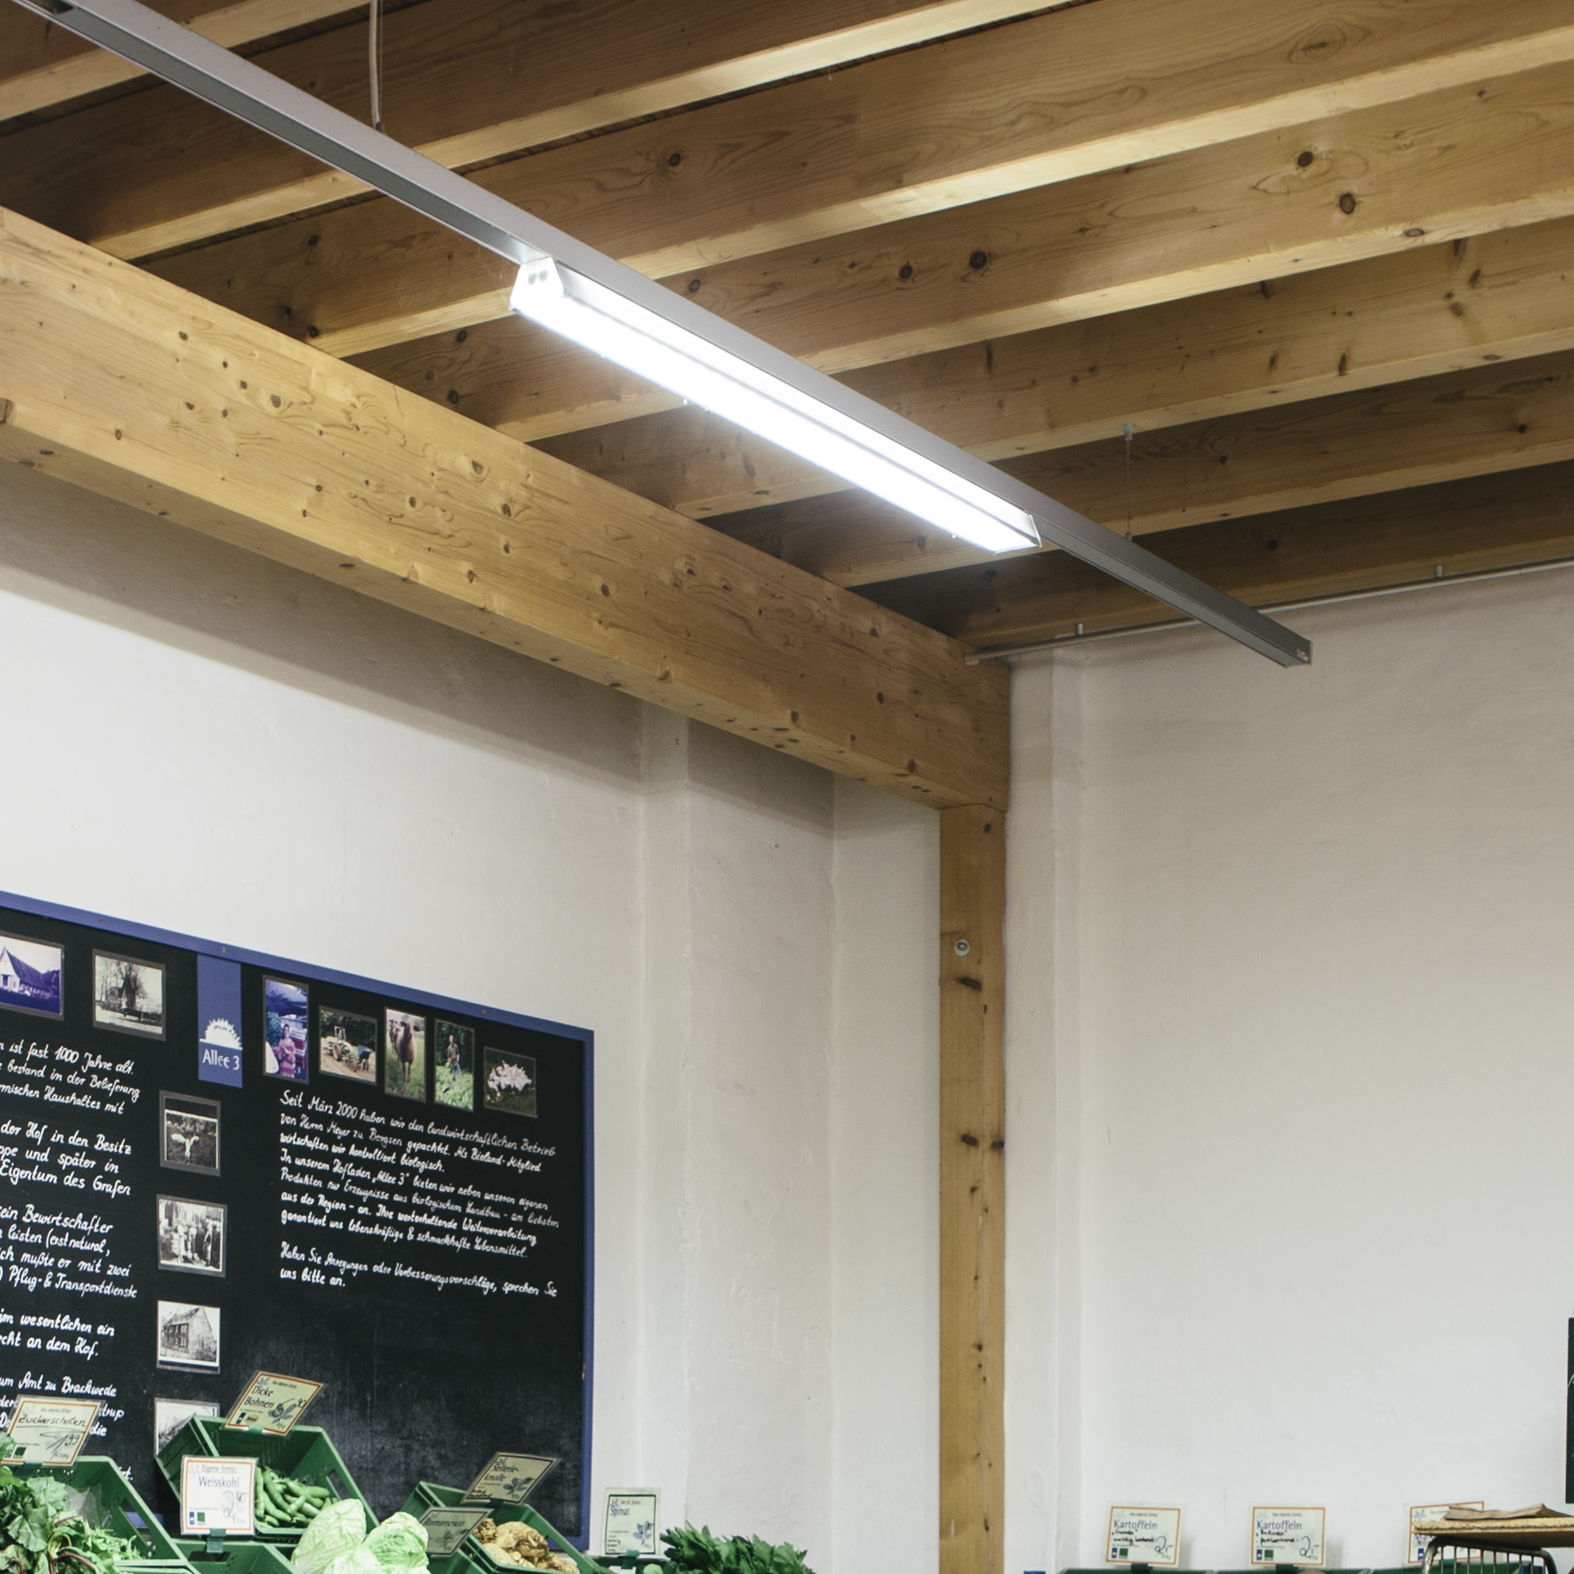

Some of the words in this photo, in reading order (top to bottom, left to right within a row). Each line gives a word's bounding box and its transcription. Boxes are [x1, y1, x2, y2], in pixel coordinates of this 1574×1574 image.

[8, 1038, 26, 1055] ist
[25, 1041, 50, 1062] fast
[54, 1045, 81, 1064] 1000
[81, 1051, 114, 1074] Jahre
[202, 1048, 230, 1067] Allee
[231, 1053, 240, 1071] 3
[7, 1058, 47, 1078] bestand
[49, 1068, 64, 1082] in
[66, 1070, 87, 1086] der
[89, 1074, 142, 1104] Belieferung
[43, 1084, 102, 1110] Haushaltes
[104, 1100, 127, 1115] mit
[279, 1089, 305, 1108] Seit
[307, 1095, 335, 1115] März
[335, 1100, 360, 1120] 2000
[358, 1108, 387, 1125] haben
[390, 1116, 407, 1129] wir
[408, 1118, 426, 1133] den
[0, 1119, 23, 1136] der
[25, 1120, 49, 1146] Hof
[50, 1129, 66, 1144] in
[67, 1129, 90, 1148] den
[93, 1133, 133, 1155] Besitz
[24, 1146, 52, 1163] und
[57, 1150, 98, 1171] später
[104, 1158, 120, 1174] in
[21, 1203, 115, 1236] Bewirtschafter
[279, 1267, 298, 1281] uns
[301, 1267, 327, 1285] bitte
[280, 1240, 307, 1262] Haben
[307, 1246, 323, 1265] Sie
[372, 1261, 393, 1275] oder
[501, 1281, 541, 1296] sprechen
[544, 1280, 559, 1298] Sie
[243, 1395, 274, 1410] Bohnen
[251, 1385, 274, 1397] Dicke
[198, 1475, 240, 1488] Weisskohl
[1113, 1518, 1158, 1532] Kartoffeln
[1256, 1518, 1303, 1532] Kartoffeln
